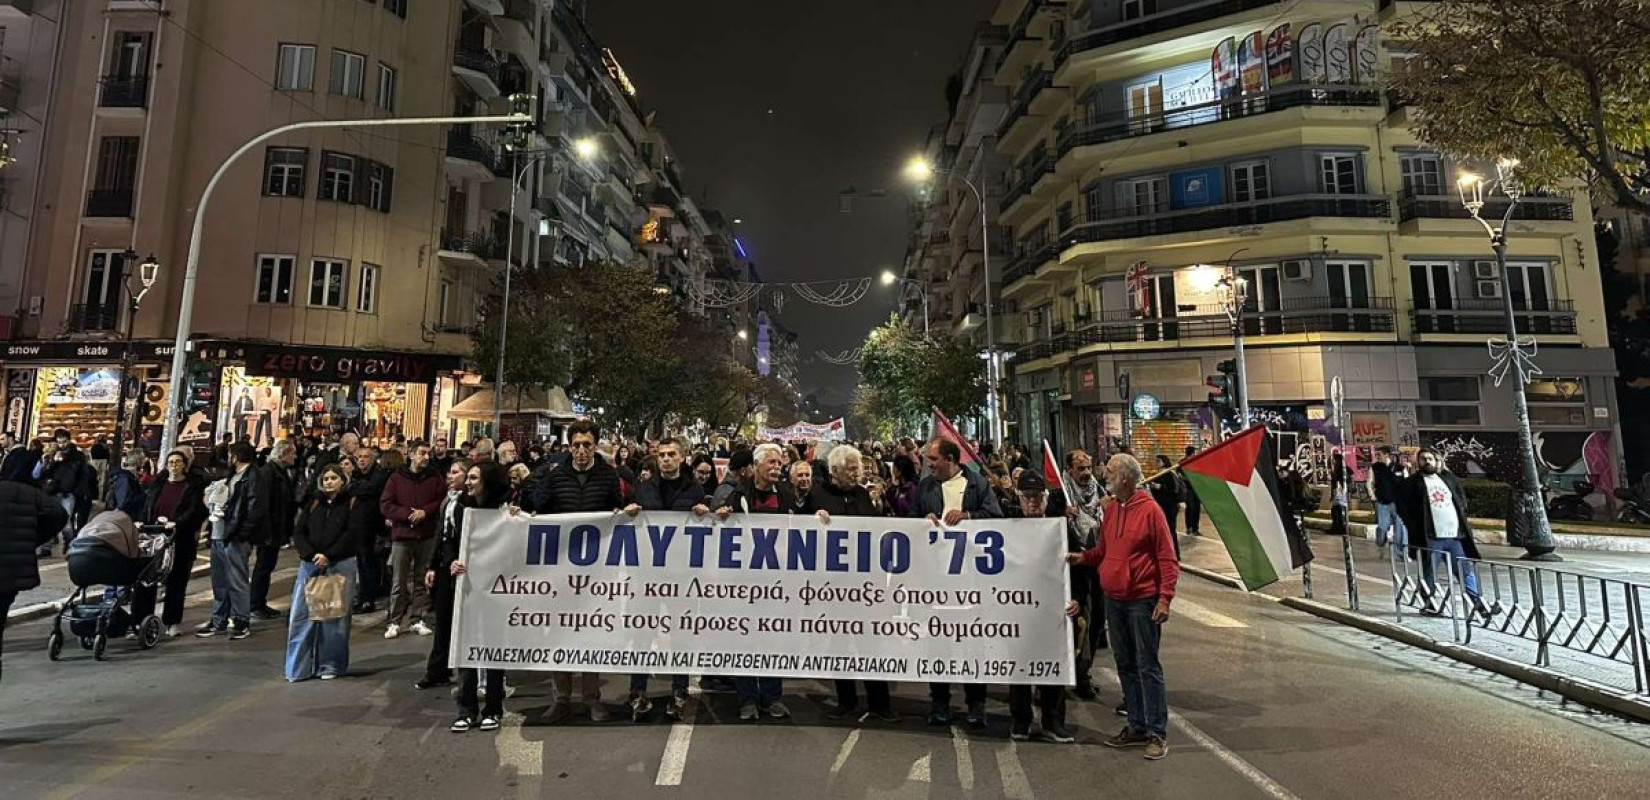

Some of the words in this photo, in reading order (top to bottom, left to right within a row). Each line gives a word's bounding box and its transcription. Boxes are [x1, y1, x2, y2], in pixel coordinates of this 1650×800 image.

[8, 345, 40, 355] snow
[77, 344, 109, 356] skate
[155, 346, 176, 355] sur
[264, 353, 326, 372] zero
[337, 356, 426, 379] gravity
[525, 524, 911, 574] ΠΟΛΥΤΕΧΝΕΙΟ
[490, 574, 558, 599] Δίκιο,
[568, 575, 635, 600] Ψωμί,
[644, 580, 679, 598] και
[686, 577, 790, 603] Λευτεριά,
[800, 580, 885, 606] φώναξε
[893, 584, 947, 605] όπου
[956, 589, 981, 604] να
[508, 607, 550, 628] έτσι
[559, 607, 614, 632] τιμάς
[623, 613, 672, 632] τους
[679, 610, 750, 635] ήρωες
[758, 616, 792, 632] και
[800, 613, 863, 635] πάντα
[870, 619, 920, 640] τους
[928, 616, 1020, 642] θυμάσαι
[468, 646, 551, 664] ΣΥΝΔΕΣΜΟΣ
[553, 648, 668, 667] ΦΥΛΑΚΙΣΘΕΝΤΩΝ
[670, 651, 694, 667] ΚΑΙ
[697, 651, 800, 670] ΕΞΟΡΙΣΘΕΝΤΩΝ
[801, 654, 907, 675] ΑΝΤΙΣΤΑΣΙΑΚΩΝ
[916, 657, 980, 678] (Σ.Φ.Ε.Α.)
[984, 660, 1016, 677] 1967
[1027, 660, 1060, 678] 1974
